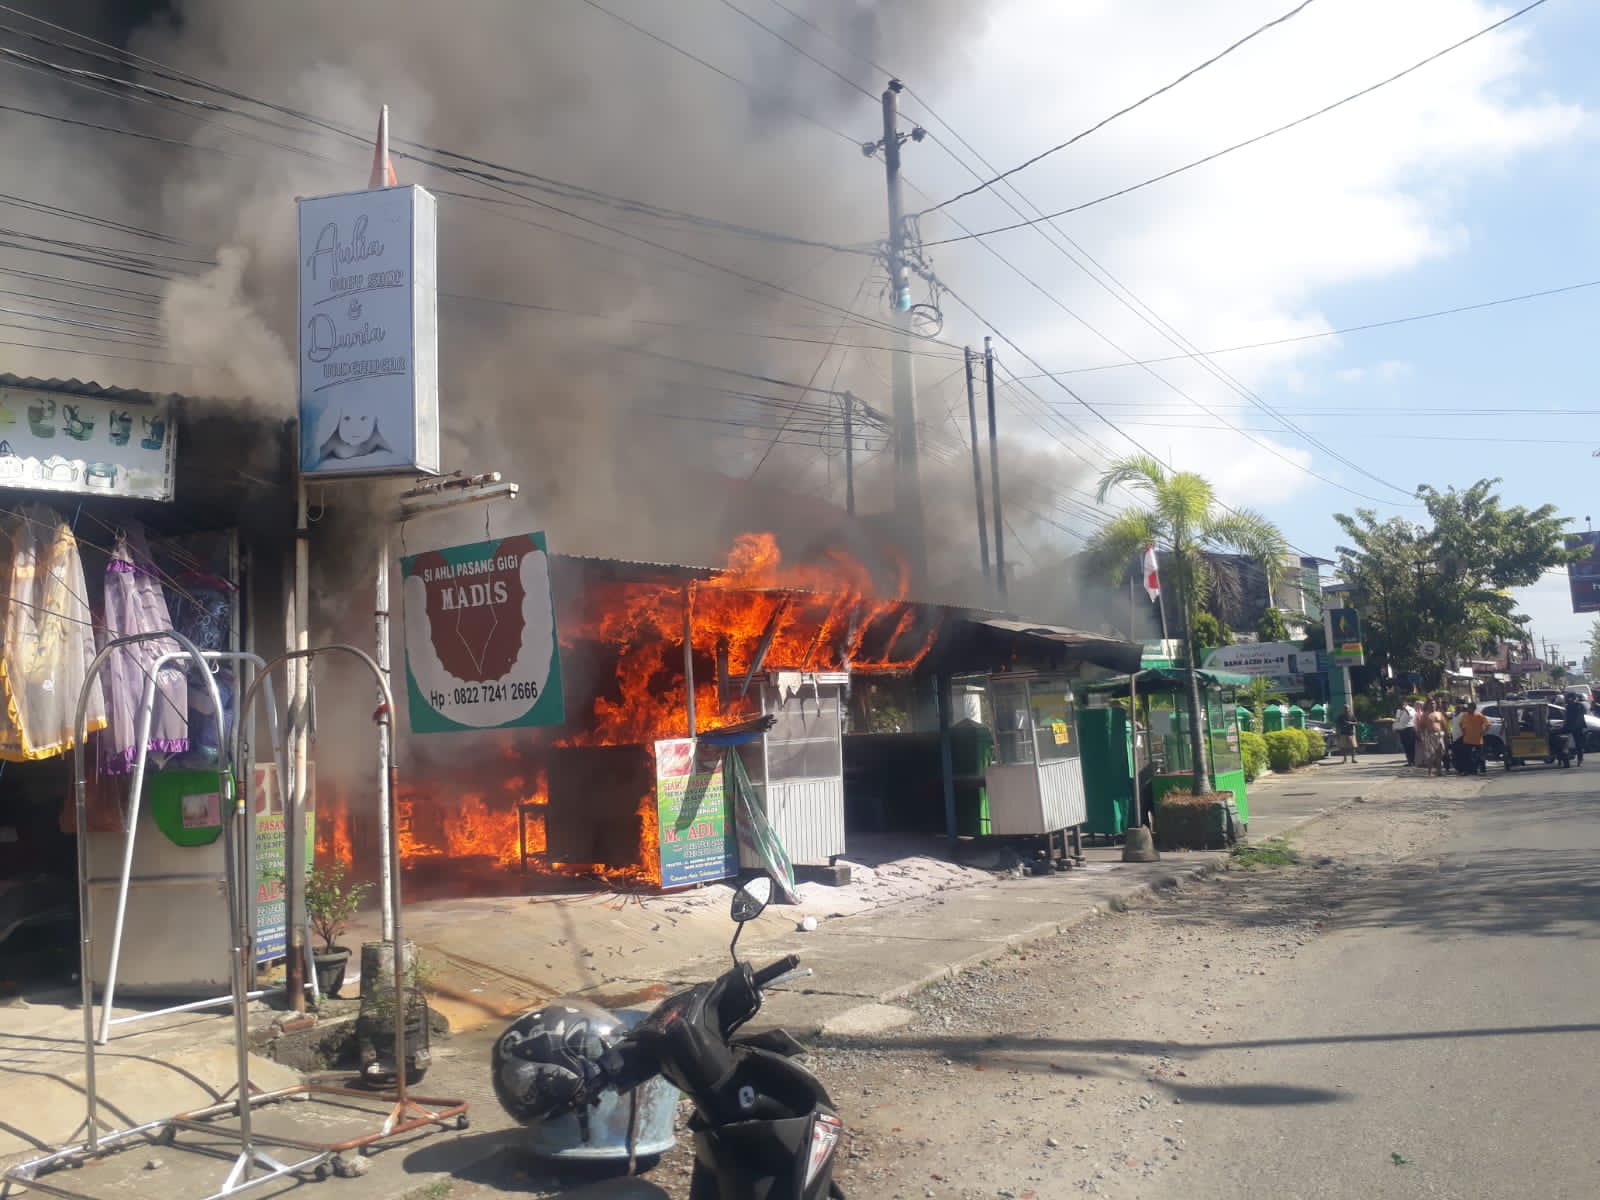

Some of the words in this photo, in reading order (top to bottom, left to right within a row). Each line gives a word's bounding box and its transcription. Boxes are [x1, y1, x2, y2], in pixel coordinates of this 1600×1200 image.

[424, 568, 433, 583] SI
[435, 564, 455, 580] AHLI
[457, 558, 495, 577] PASANG
[497, 555, 519, 570] GIGI
[454, 687, 480, 704] 0822
[482, 684, 508, 703] 7241
[511, 681, 538, 700] 2666
